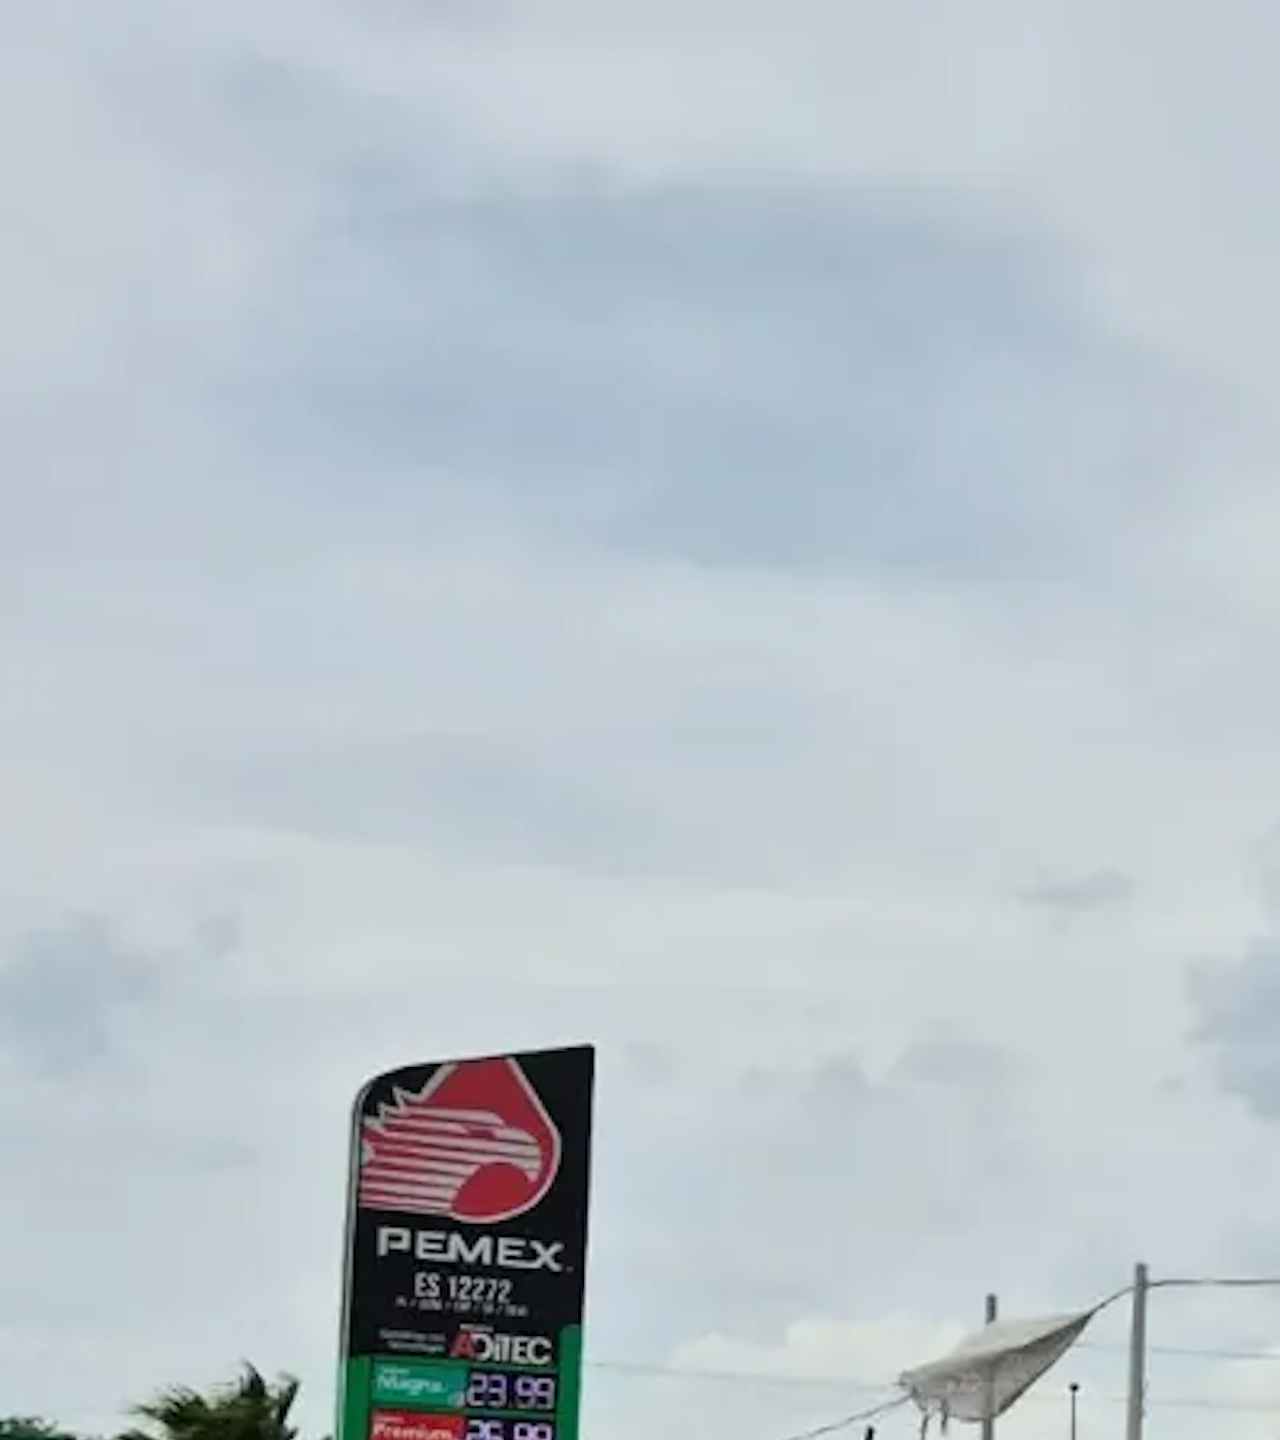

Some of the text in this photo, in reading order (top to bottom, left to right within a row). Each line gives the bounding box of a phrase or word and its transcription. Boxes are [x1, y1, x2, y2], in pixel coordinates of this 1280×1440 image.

[376, 1226, 566, 1272] PEMEX
[413, 1271, 441, 1298] ES
[376, 1375, 444, 1396] Magna
